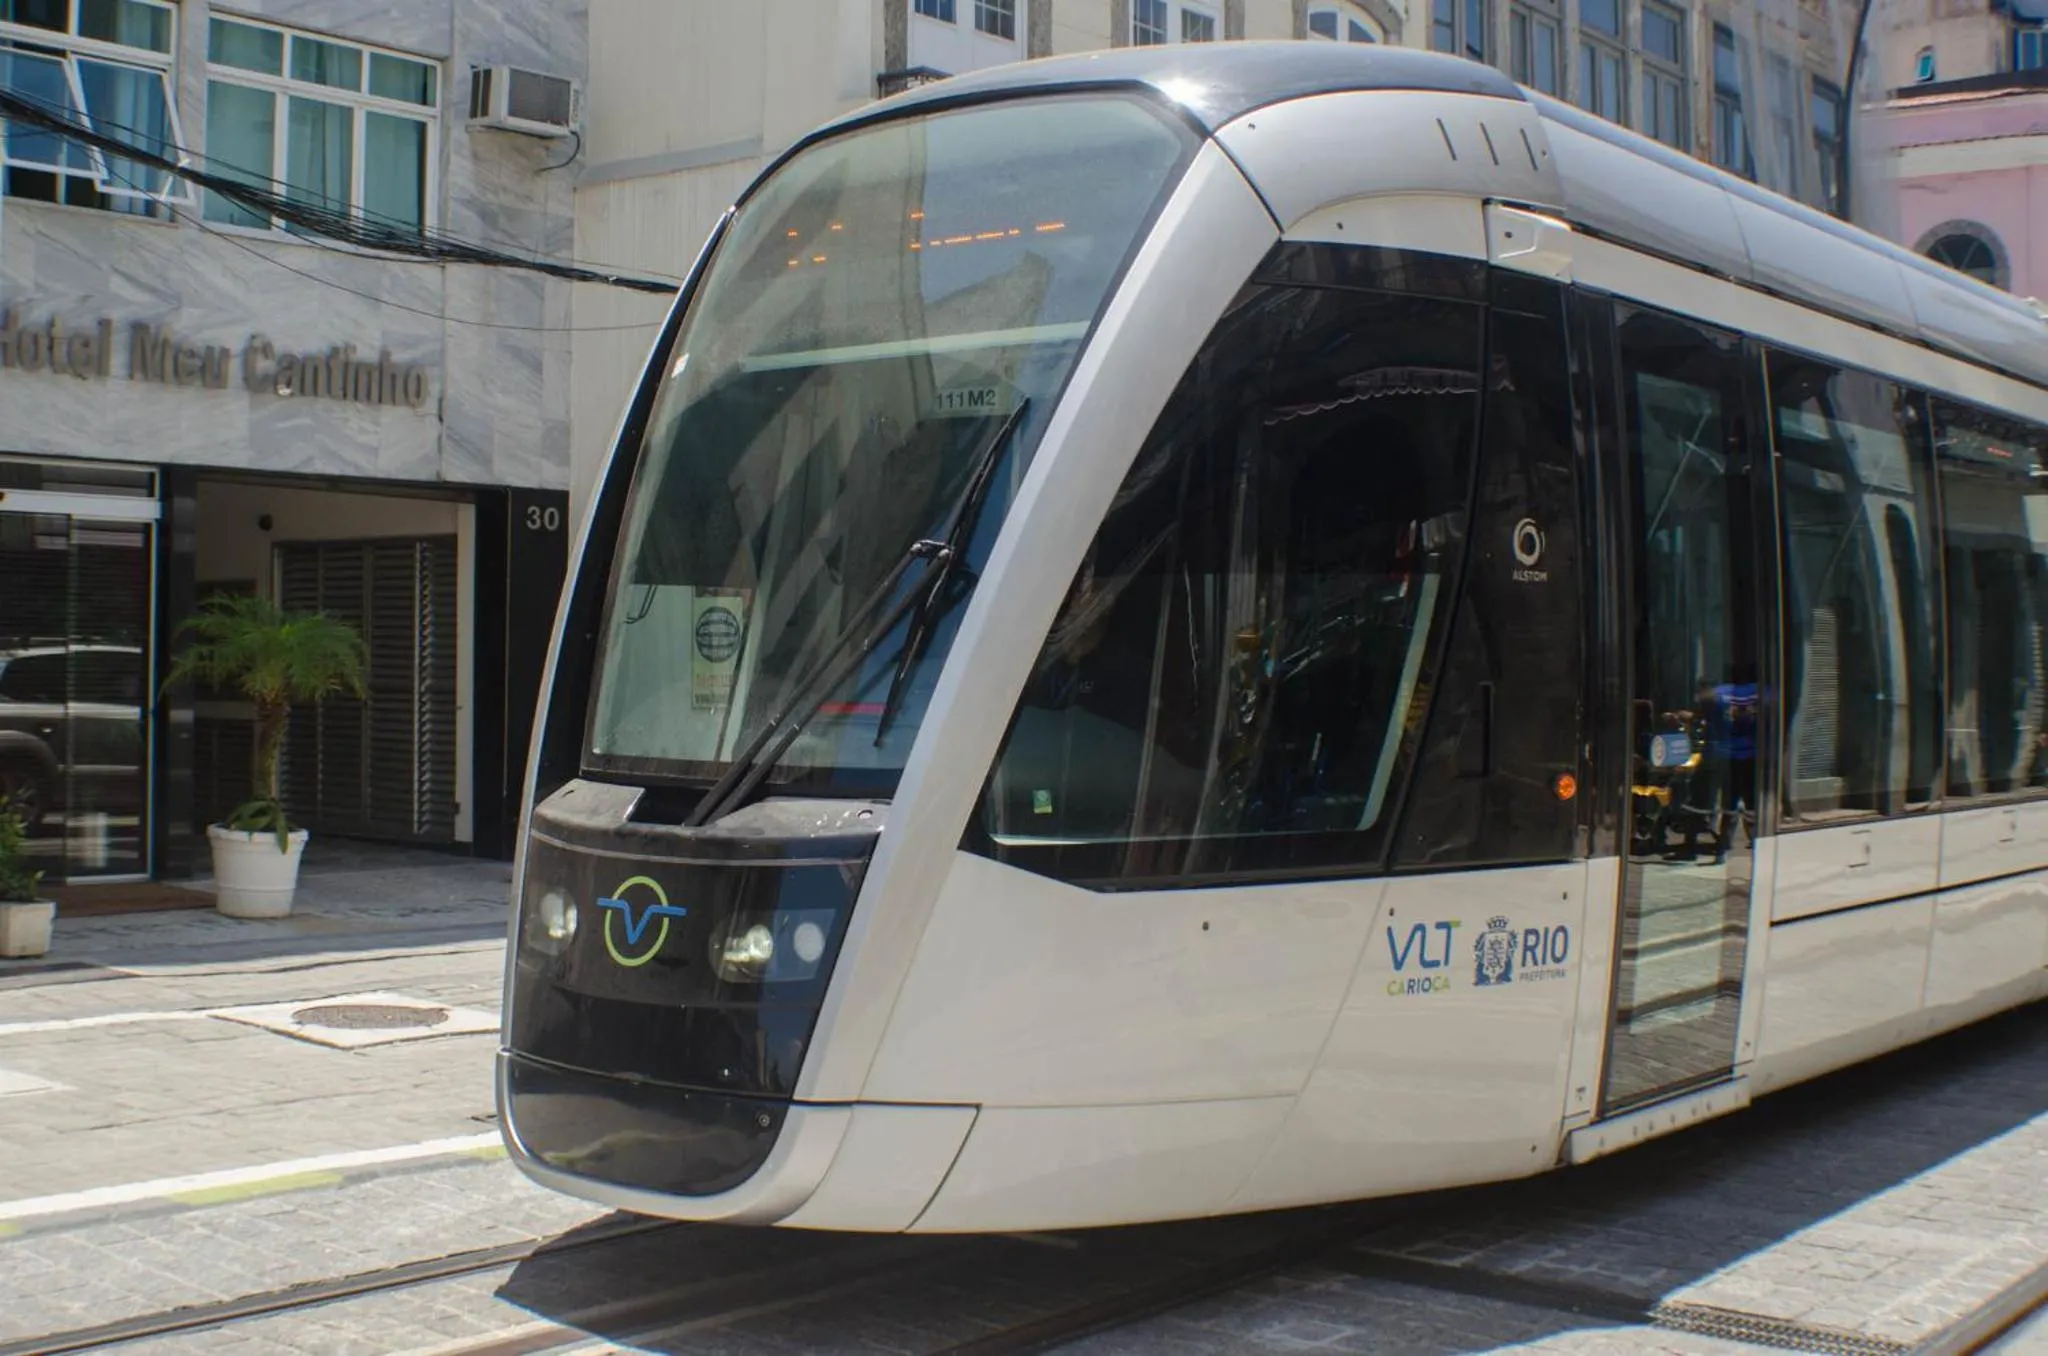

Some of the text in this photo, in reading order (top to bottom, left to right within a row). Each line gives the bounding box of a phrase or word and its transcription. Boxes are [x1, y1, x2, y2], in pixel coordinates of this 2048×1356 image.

[128, 322, 230, 389] Meu
[245, 332, 430, 407] Cantinho
[937, 389, 996, 409] 111M2
[526, 505, 559, 530] 30
[1512, 569, 1548, 582] ALSTOM
[1387, 921, 1462, 971] VLT
[1521, 925, 1569, 967] RIO
[1387, 976, 1451, 996] CARIOCA
